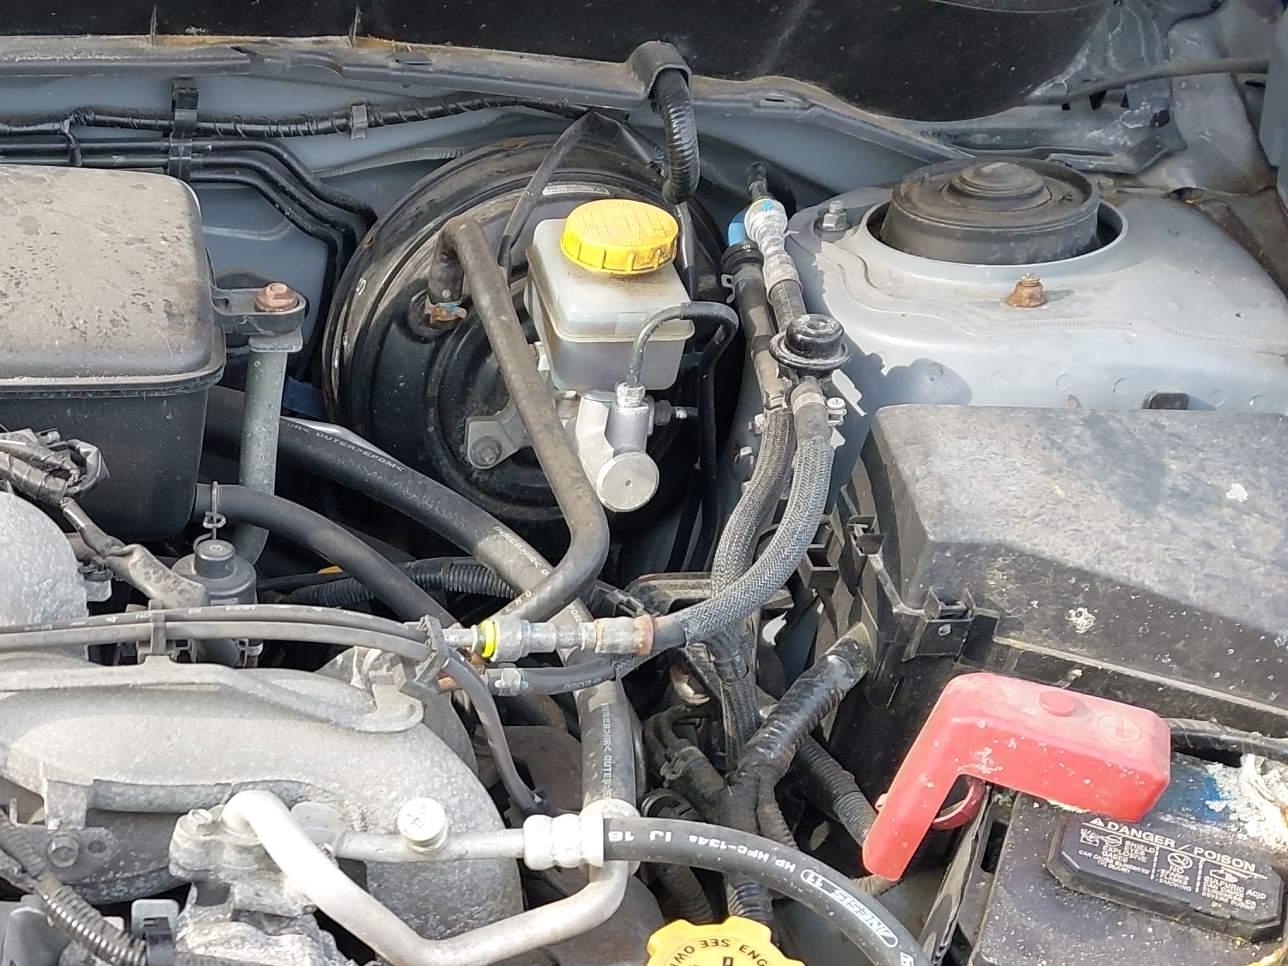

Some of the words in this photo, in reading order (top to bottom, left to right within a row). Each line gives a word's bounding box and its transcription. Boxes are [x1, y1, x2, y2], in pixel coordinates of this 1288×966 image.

[608, 830, 634, 843] 16
[649, 830, 672, 842] IJ
[690, 835, 770, 862] HFC-134a
[1107, 821, 1177, 849] DANGER
[1194, 847, 1257, 872] POISON
[774, 856, 797, 873] HP
[1245, 889, 1267, 901] ACID
[699, 938, 731, 949] SEE
